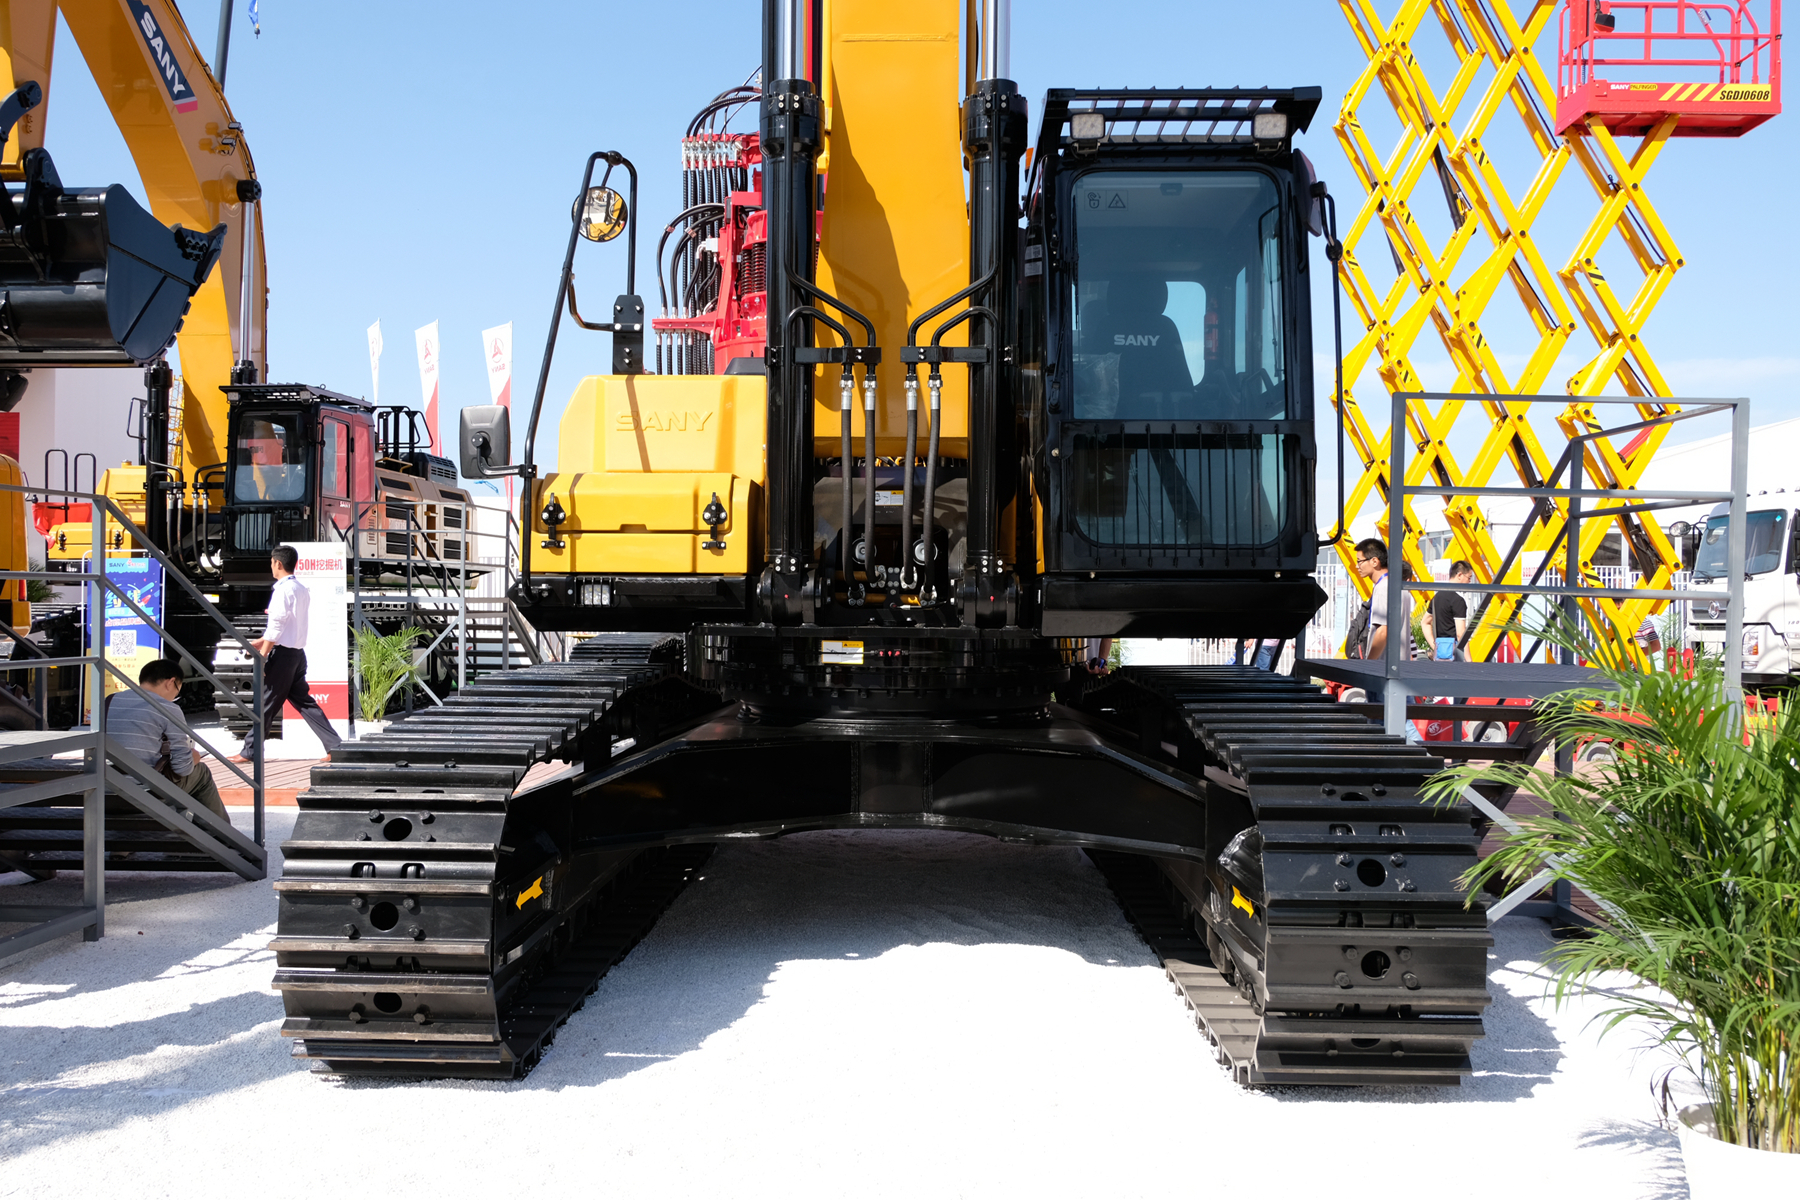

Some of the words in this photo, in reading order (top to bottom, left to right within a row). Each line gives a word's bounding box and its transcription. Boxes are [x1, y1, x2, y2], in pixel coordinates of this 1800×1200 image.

[140, 11, 187, 96] SANY
[1719, 90, 1770, 101] SGDJ0608
[1113, 333, 1161, 347] SANY
[614, 410, 714, 432] SANY
